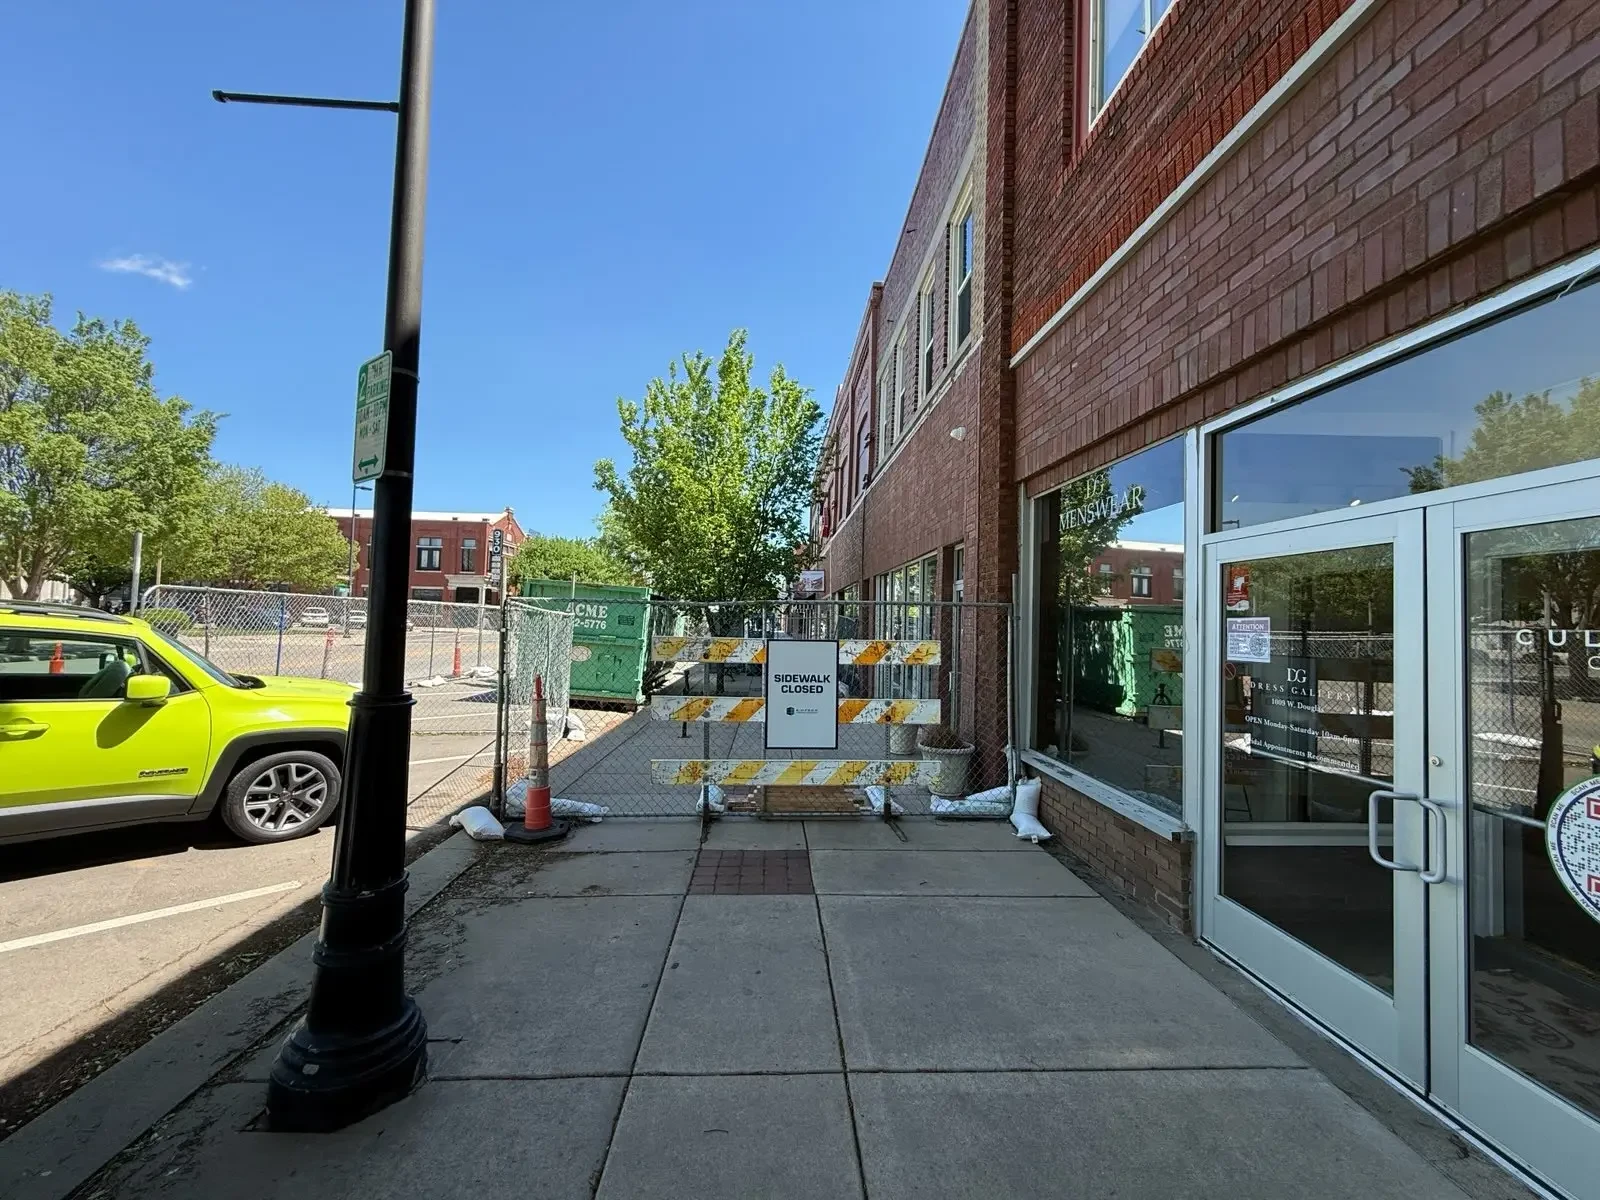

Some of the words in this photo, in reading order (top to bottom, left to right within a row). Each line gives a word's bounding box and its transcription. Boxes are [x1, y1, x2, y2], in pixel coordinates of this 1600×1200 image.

[359, 372, 366, 401] 2
[1059, 486, 1144, 533] MENSWEAR
[493, 530, 501, 553] 930
[566, 602, 609, 619] ACME
[774, 674, 831, 683] SIDEWALK
[1286, 667, 1307, 683] DG
[781, 684, 824, 694] CLOSED
[1250, 681, 1285, 693] DRESS
[1291, 686, 1352, 702] GALLERY
[1245, 715, 1263, 724] OPEN
[1263, 741, 1306, 757] Appointments
[1307, 751, 1360, 770] Recommended
[1571, 784, 1588, 796] SCAN
[1550, 809, 1560, 828] SCAN
[1580, 897, 1600, 916] SCAN
